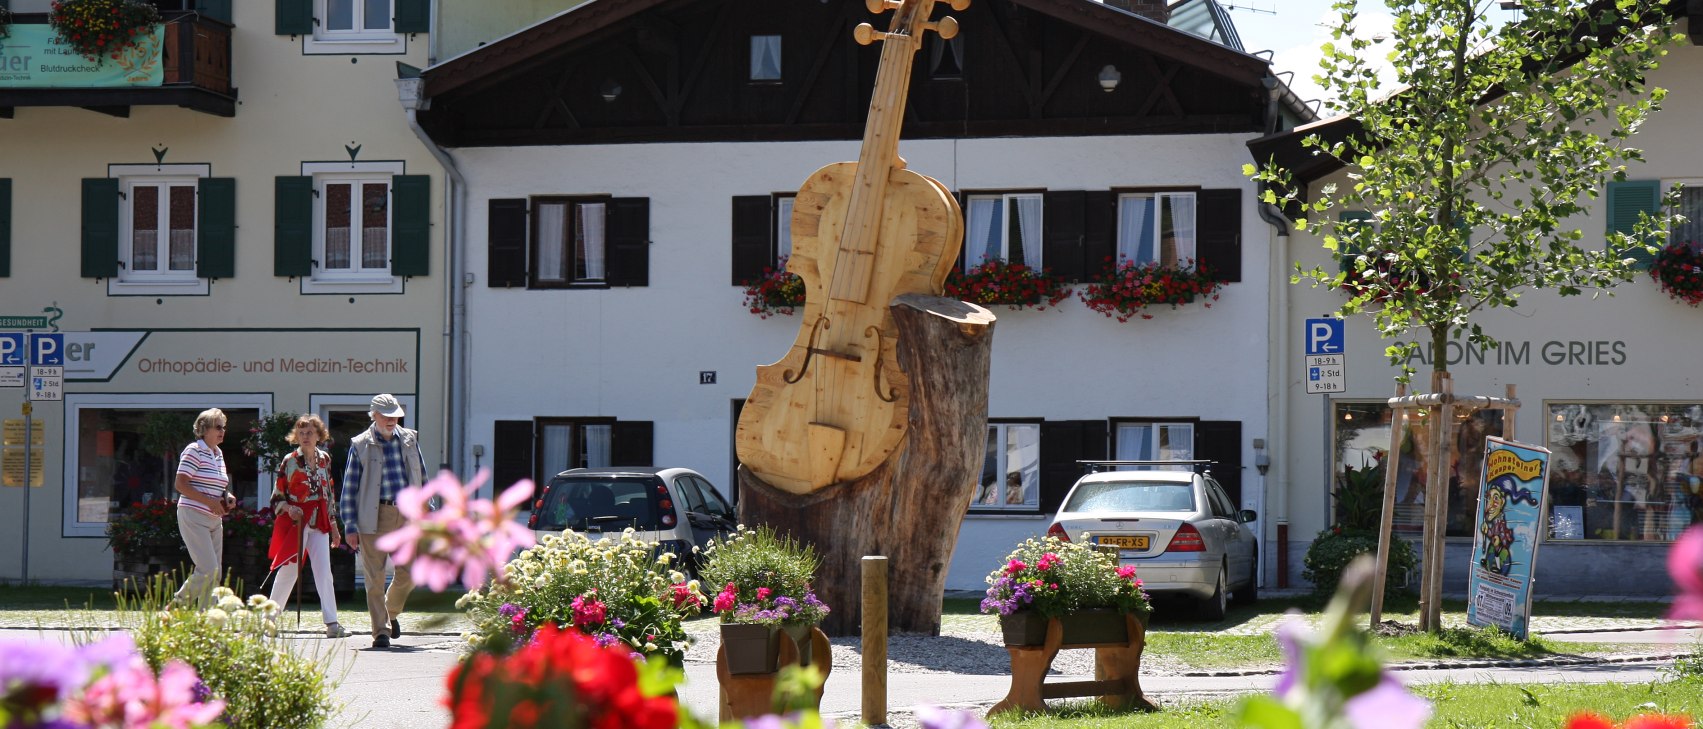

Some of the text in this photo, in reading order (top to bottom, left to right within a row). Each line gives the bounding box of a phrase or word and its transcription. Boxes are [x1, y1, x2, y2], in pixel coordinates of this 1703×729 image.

[43, 47, 56, 55] mit
[40, 64, 100, 72] Blutdruckcheck
[1311, 323, 1333, 353] P
[0, 337, 17, 364] P
[38, 337, 57, 364] P
[65, 342, 95, 361] er
[1497, 341, 1530, 365] IM
[1541, 341, 1627, 366] GRIES
[138, 357, 408, 375] Orthopädie- und Medizin-Technik
[1314, 357, 1331, 365] 18-9
[703, 372, 713, 383] 17
[1315, 382, 1332, 390] 9-18
